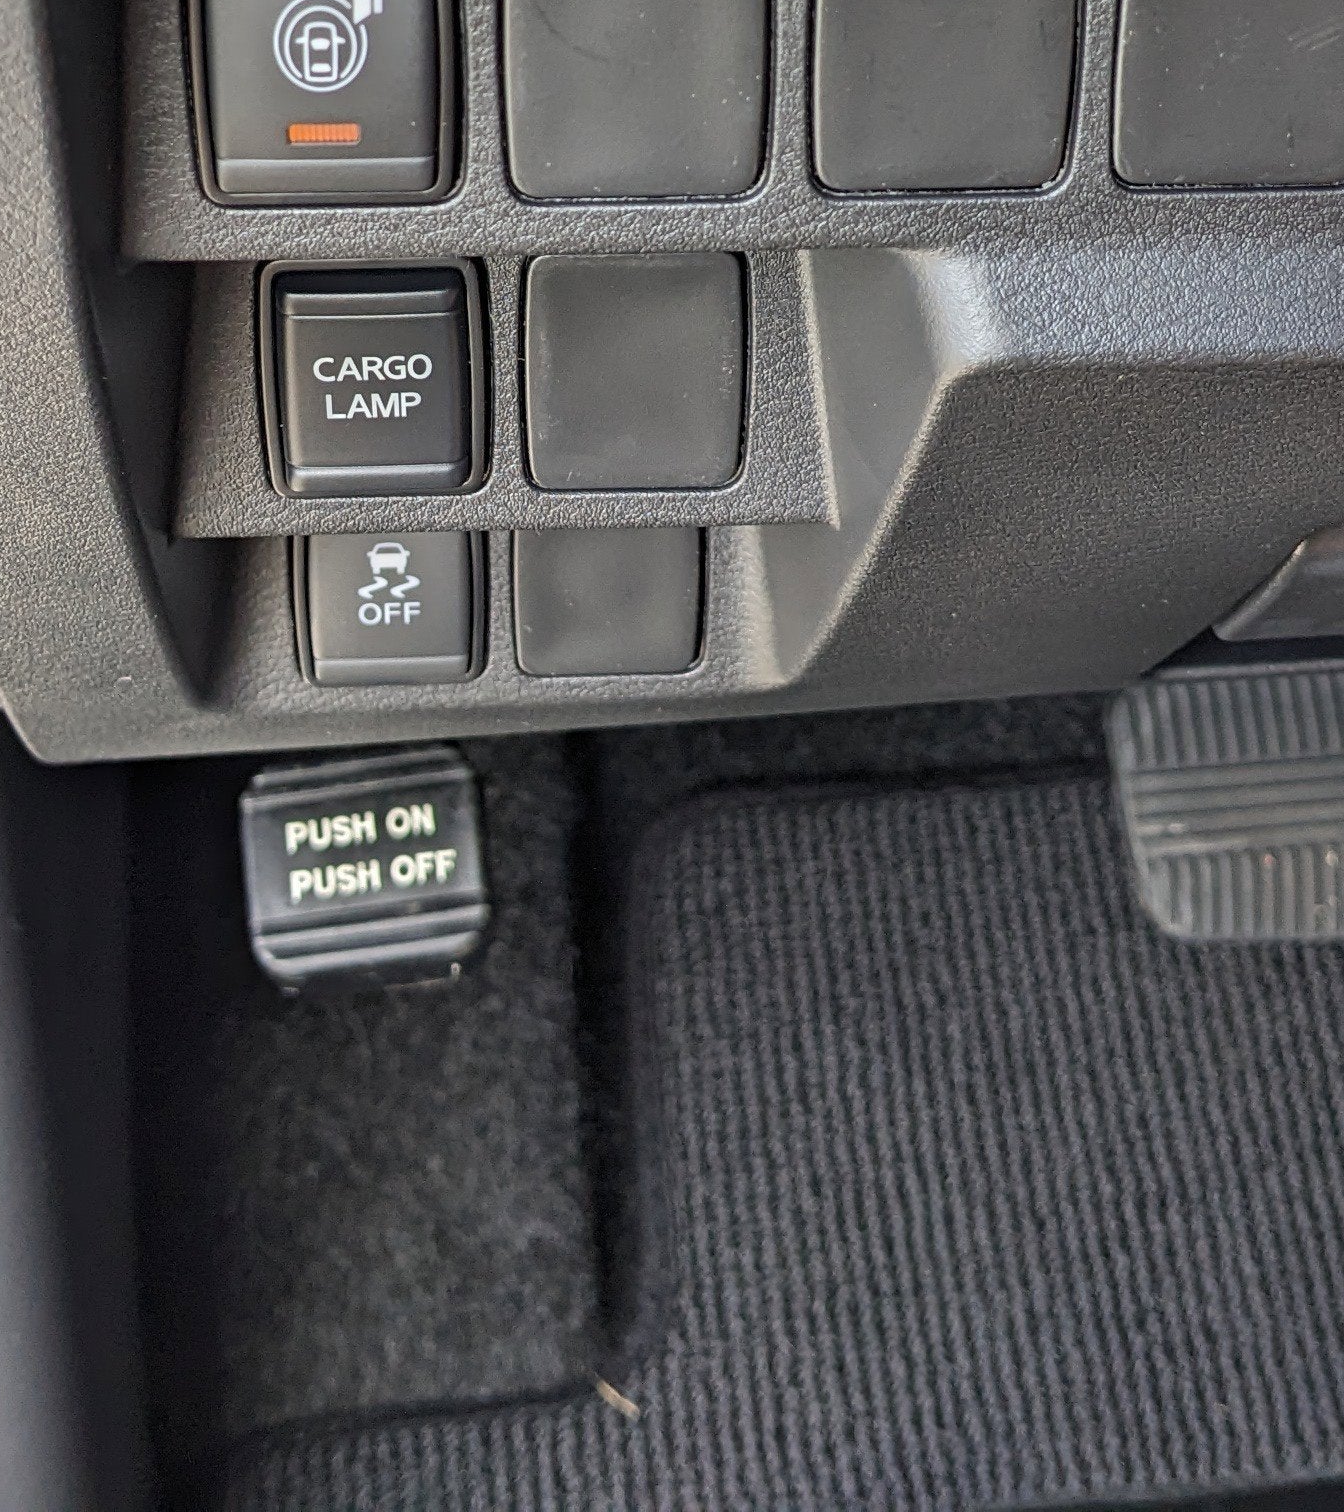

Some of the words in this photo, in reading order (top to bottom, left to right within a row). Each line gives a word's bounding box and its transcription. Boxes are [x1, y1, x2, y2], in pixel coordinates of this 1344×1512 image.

[312, 353, 433, 382] CARGO
[325, 391, 422, 419] LAMP
[358, 601, 421, 626] OFF
[284, 810, 377, 855] PUSH
[385, 803, 436, 839] ON
[289, 859, 382, 904] PUSH
[390, 848, 457, 887] OFF
